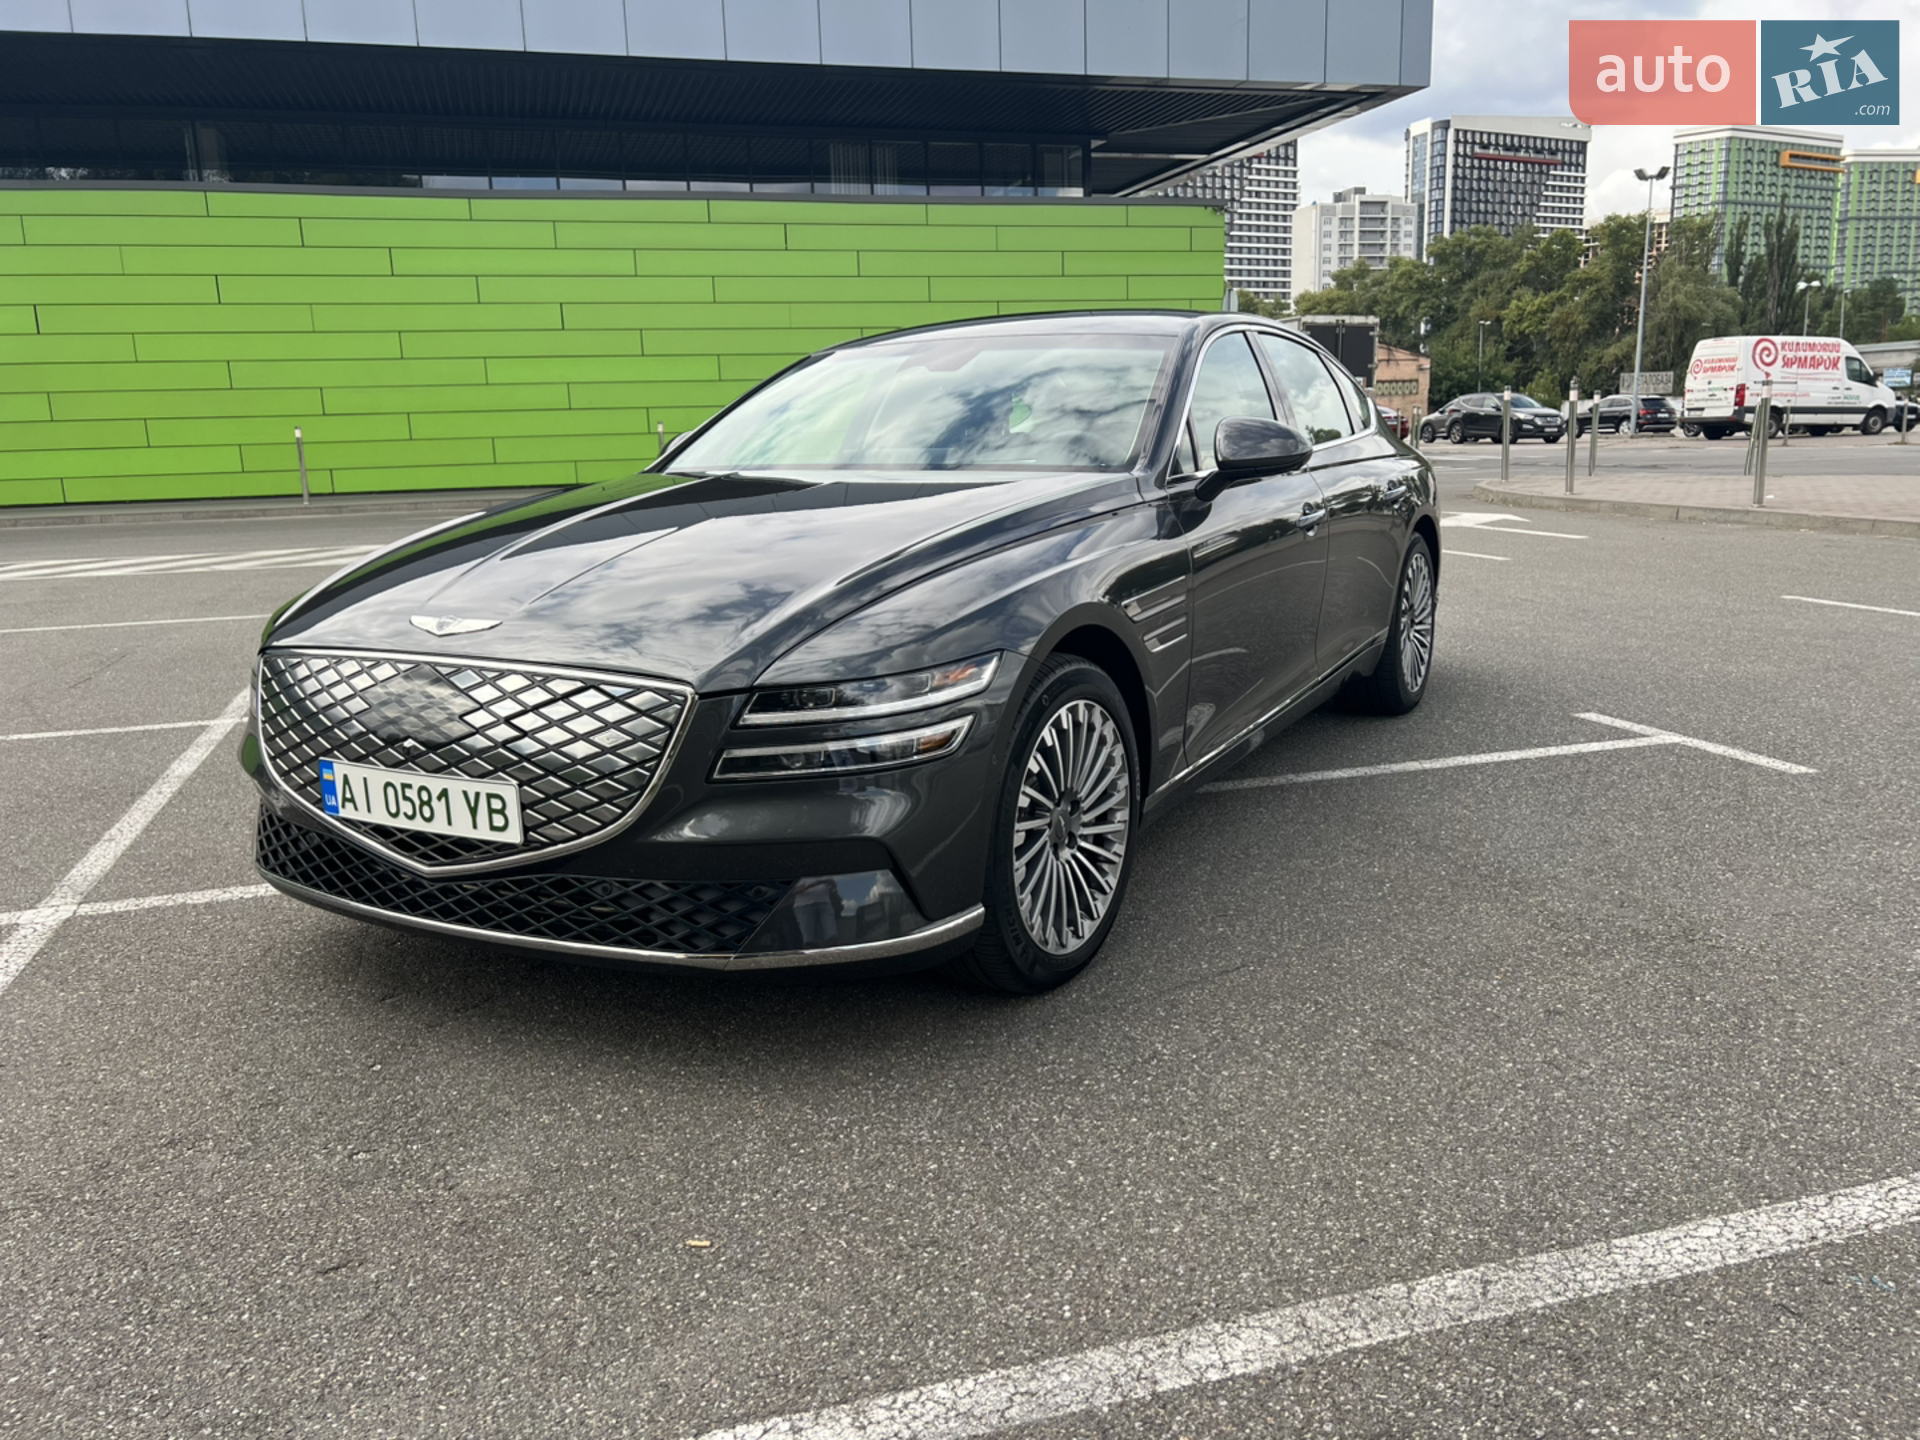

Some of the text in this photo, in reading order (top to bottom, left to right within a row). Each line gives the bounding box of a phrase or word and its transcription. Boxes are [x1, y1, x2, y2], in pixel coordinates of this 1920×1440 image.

[1780, 354, 1841, 371] ЯРМАРОК
[325, 794, 337, 806] UA
[341, 773, 509, 833] AI 0581 YB
